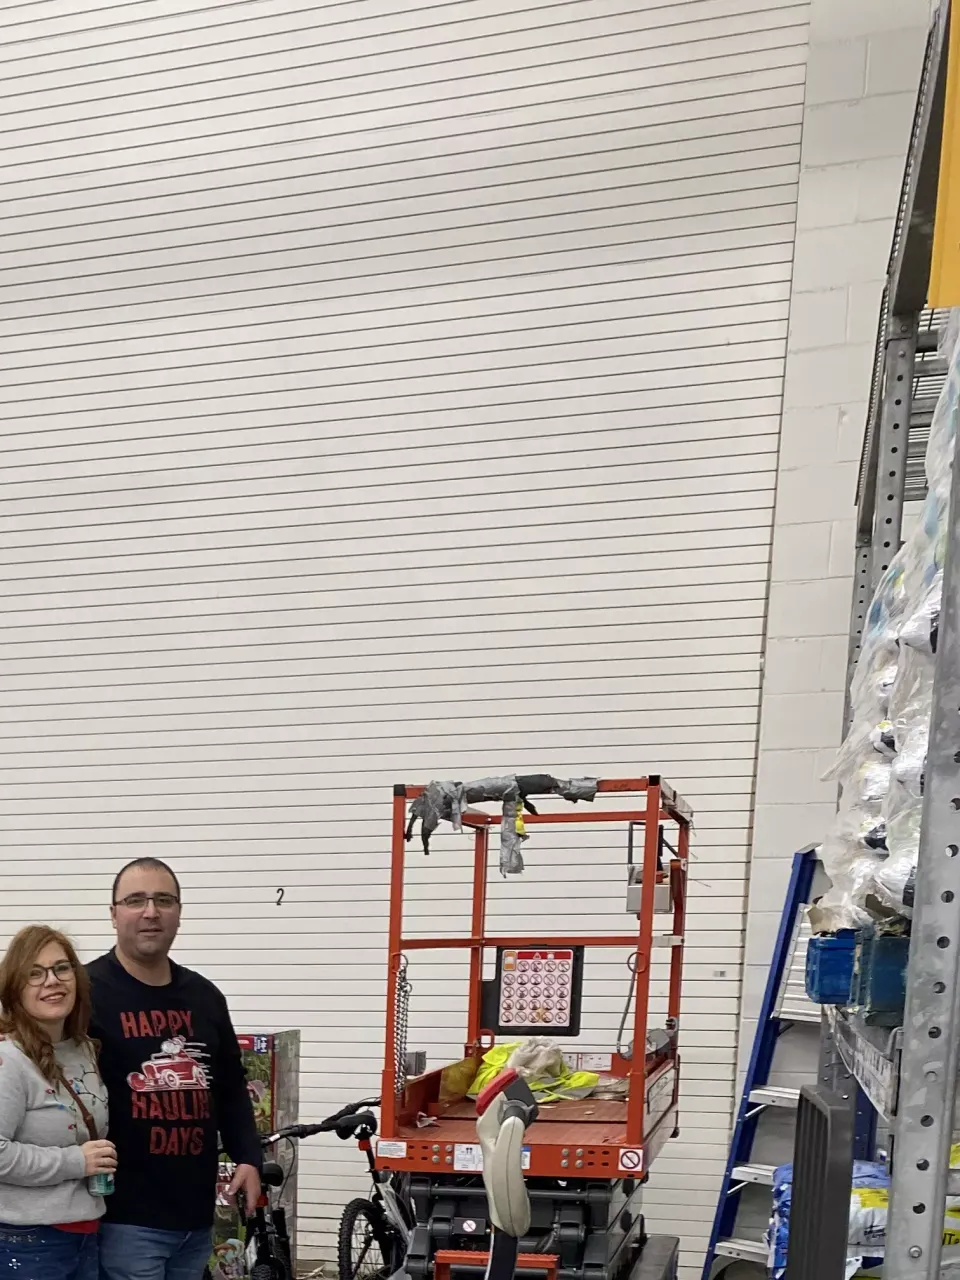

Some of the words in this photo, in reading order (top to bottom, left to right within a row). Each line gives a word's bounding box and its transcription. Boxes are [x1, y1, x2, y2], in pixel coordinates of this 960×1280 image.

[276, 887, 285, 906] 2
[120, 1010, 194, 1038] HAPPY
[150, 1126, 205, 1155] DAYS
